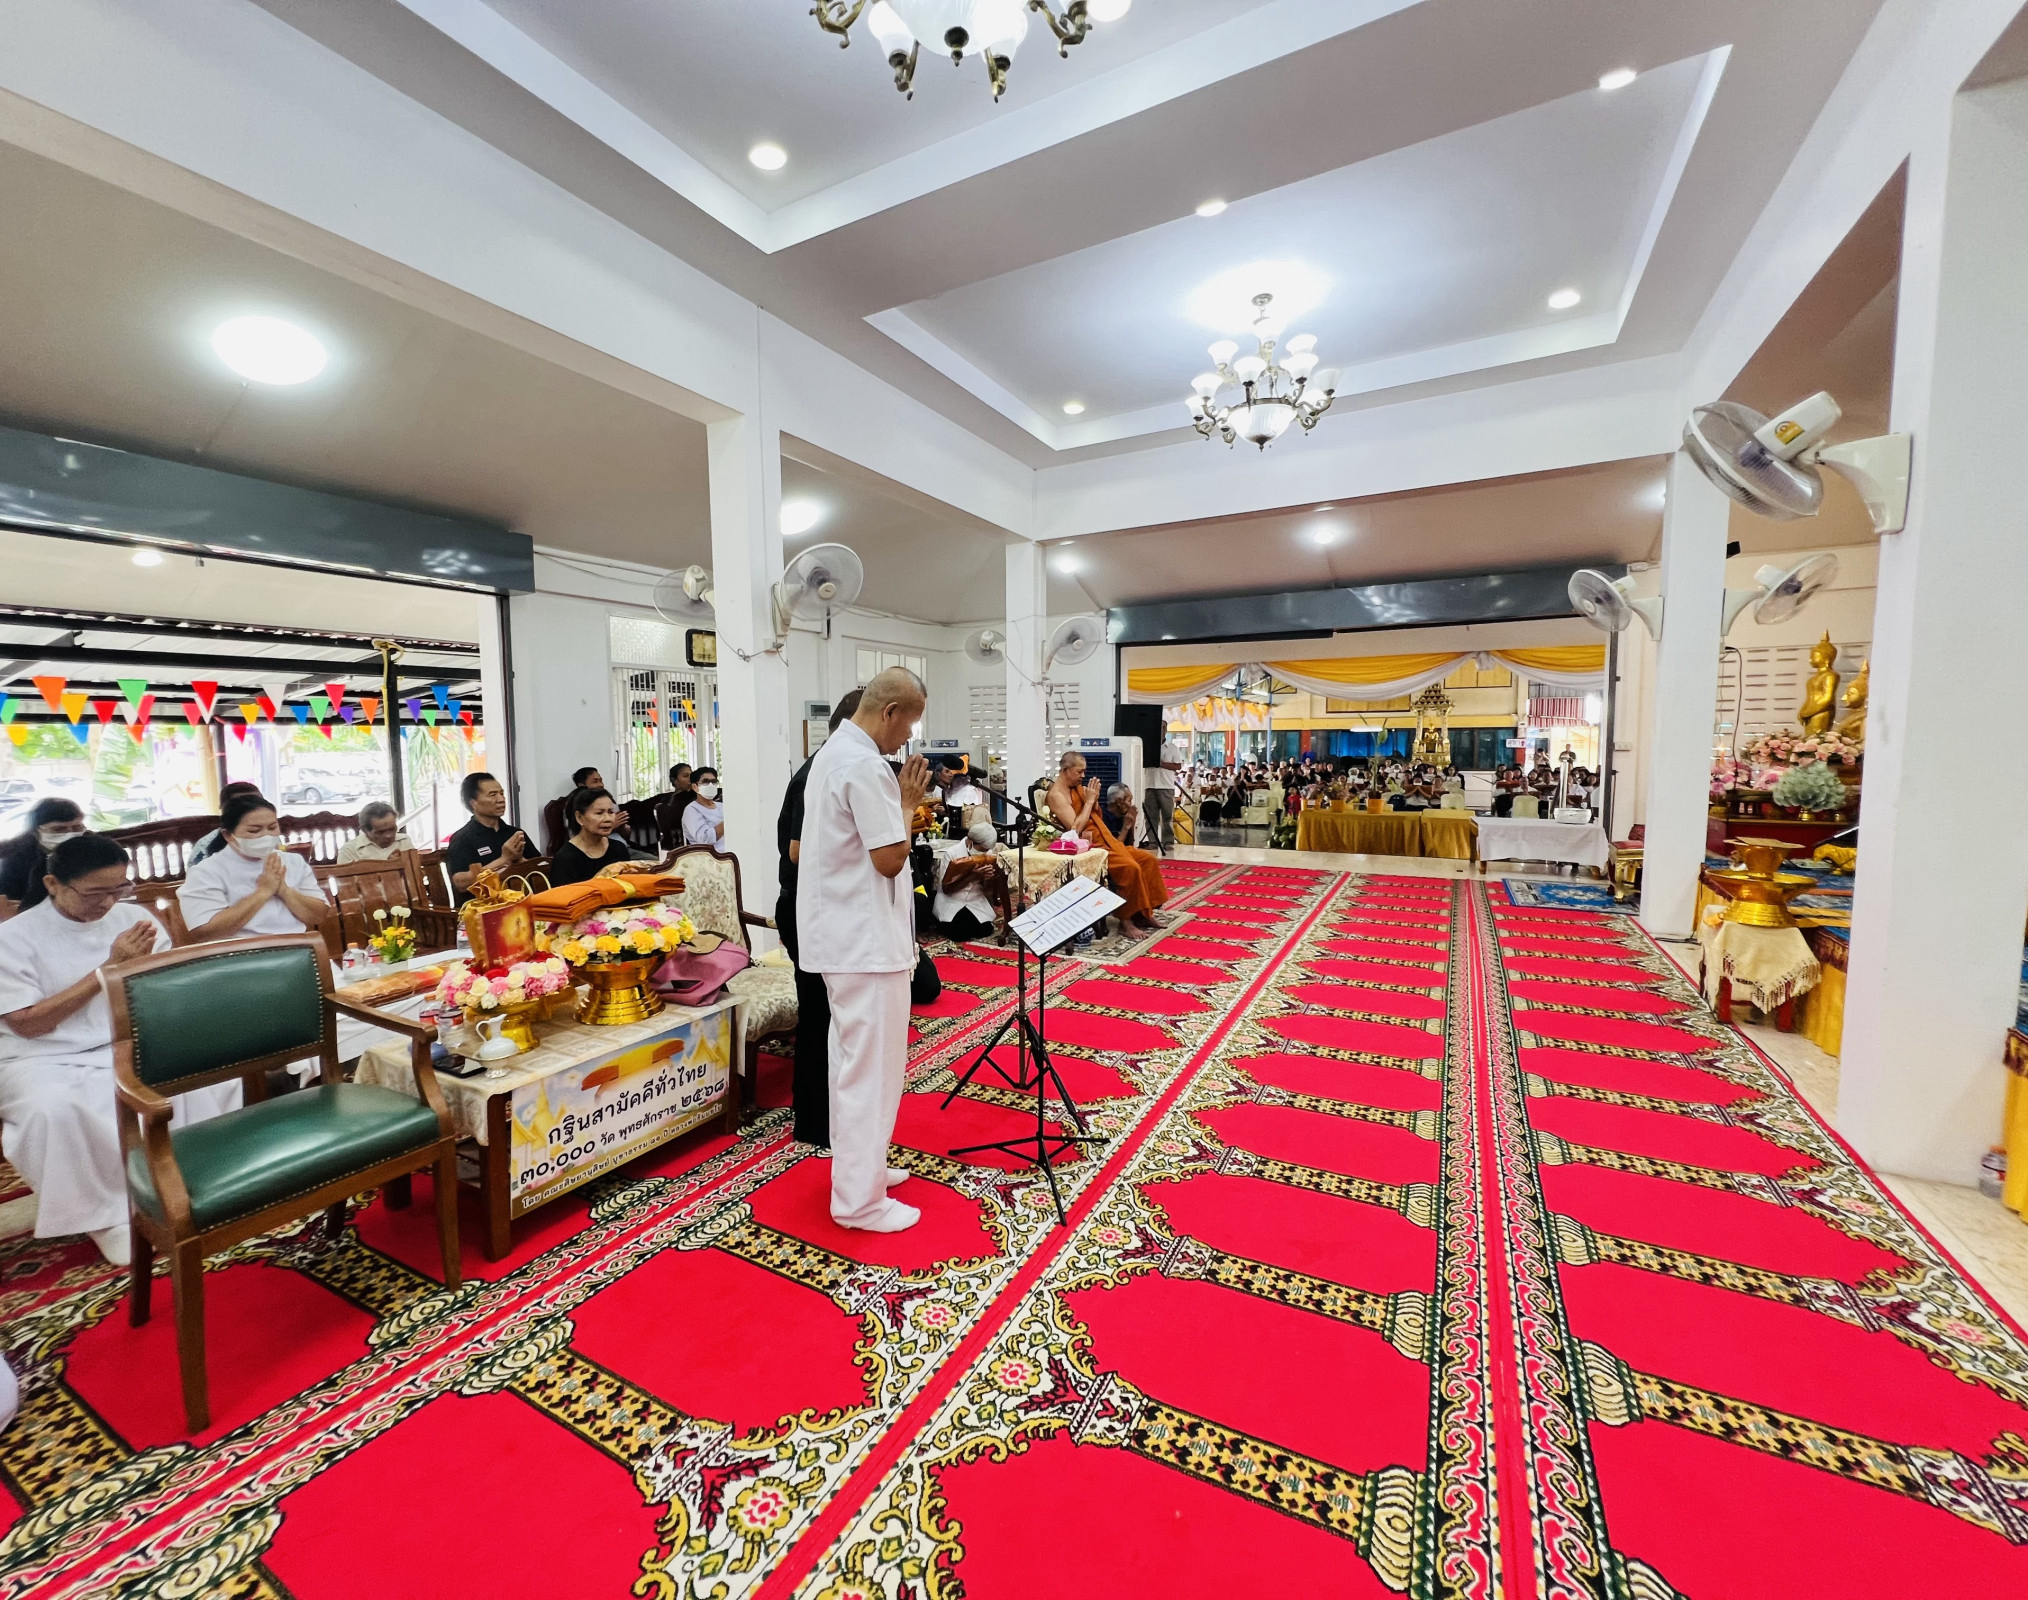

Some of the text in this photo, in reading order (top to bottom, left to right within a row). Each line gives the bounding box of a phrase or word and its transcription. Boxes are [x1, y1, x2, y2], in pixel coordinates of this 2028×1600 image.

[520, 1078, 725, 1185] ๓๐,๐๐๐ วัด พุทธศักราช ๒๕๖๘
[548, 1063, 707, 1145] กฐินสามัคคีทั่วไทย
[522, 1194, 541, 1208] โดย
